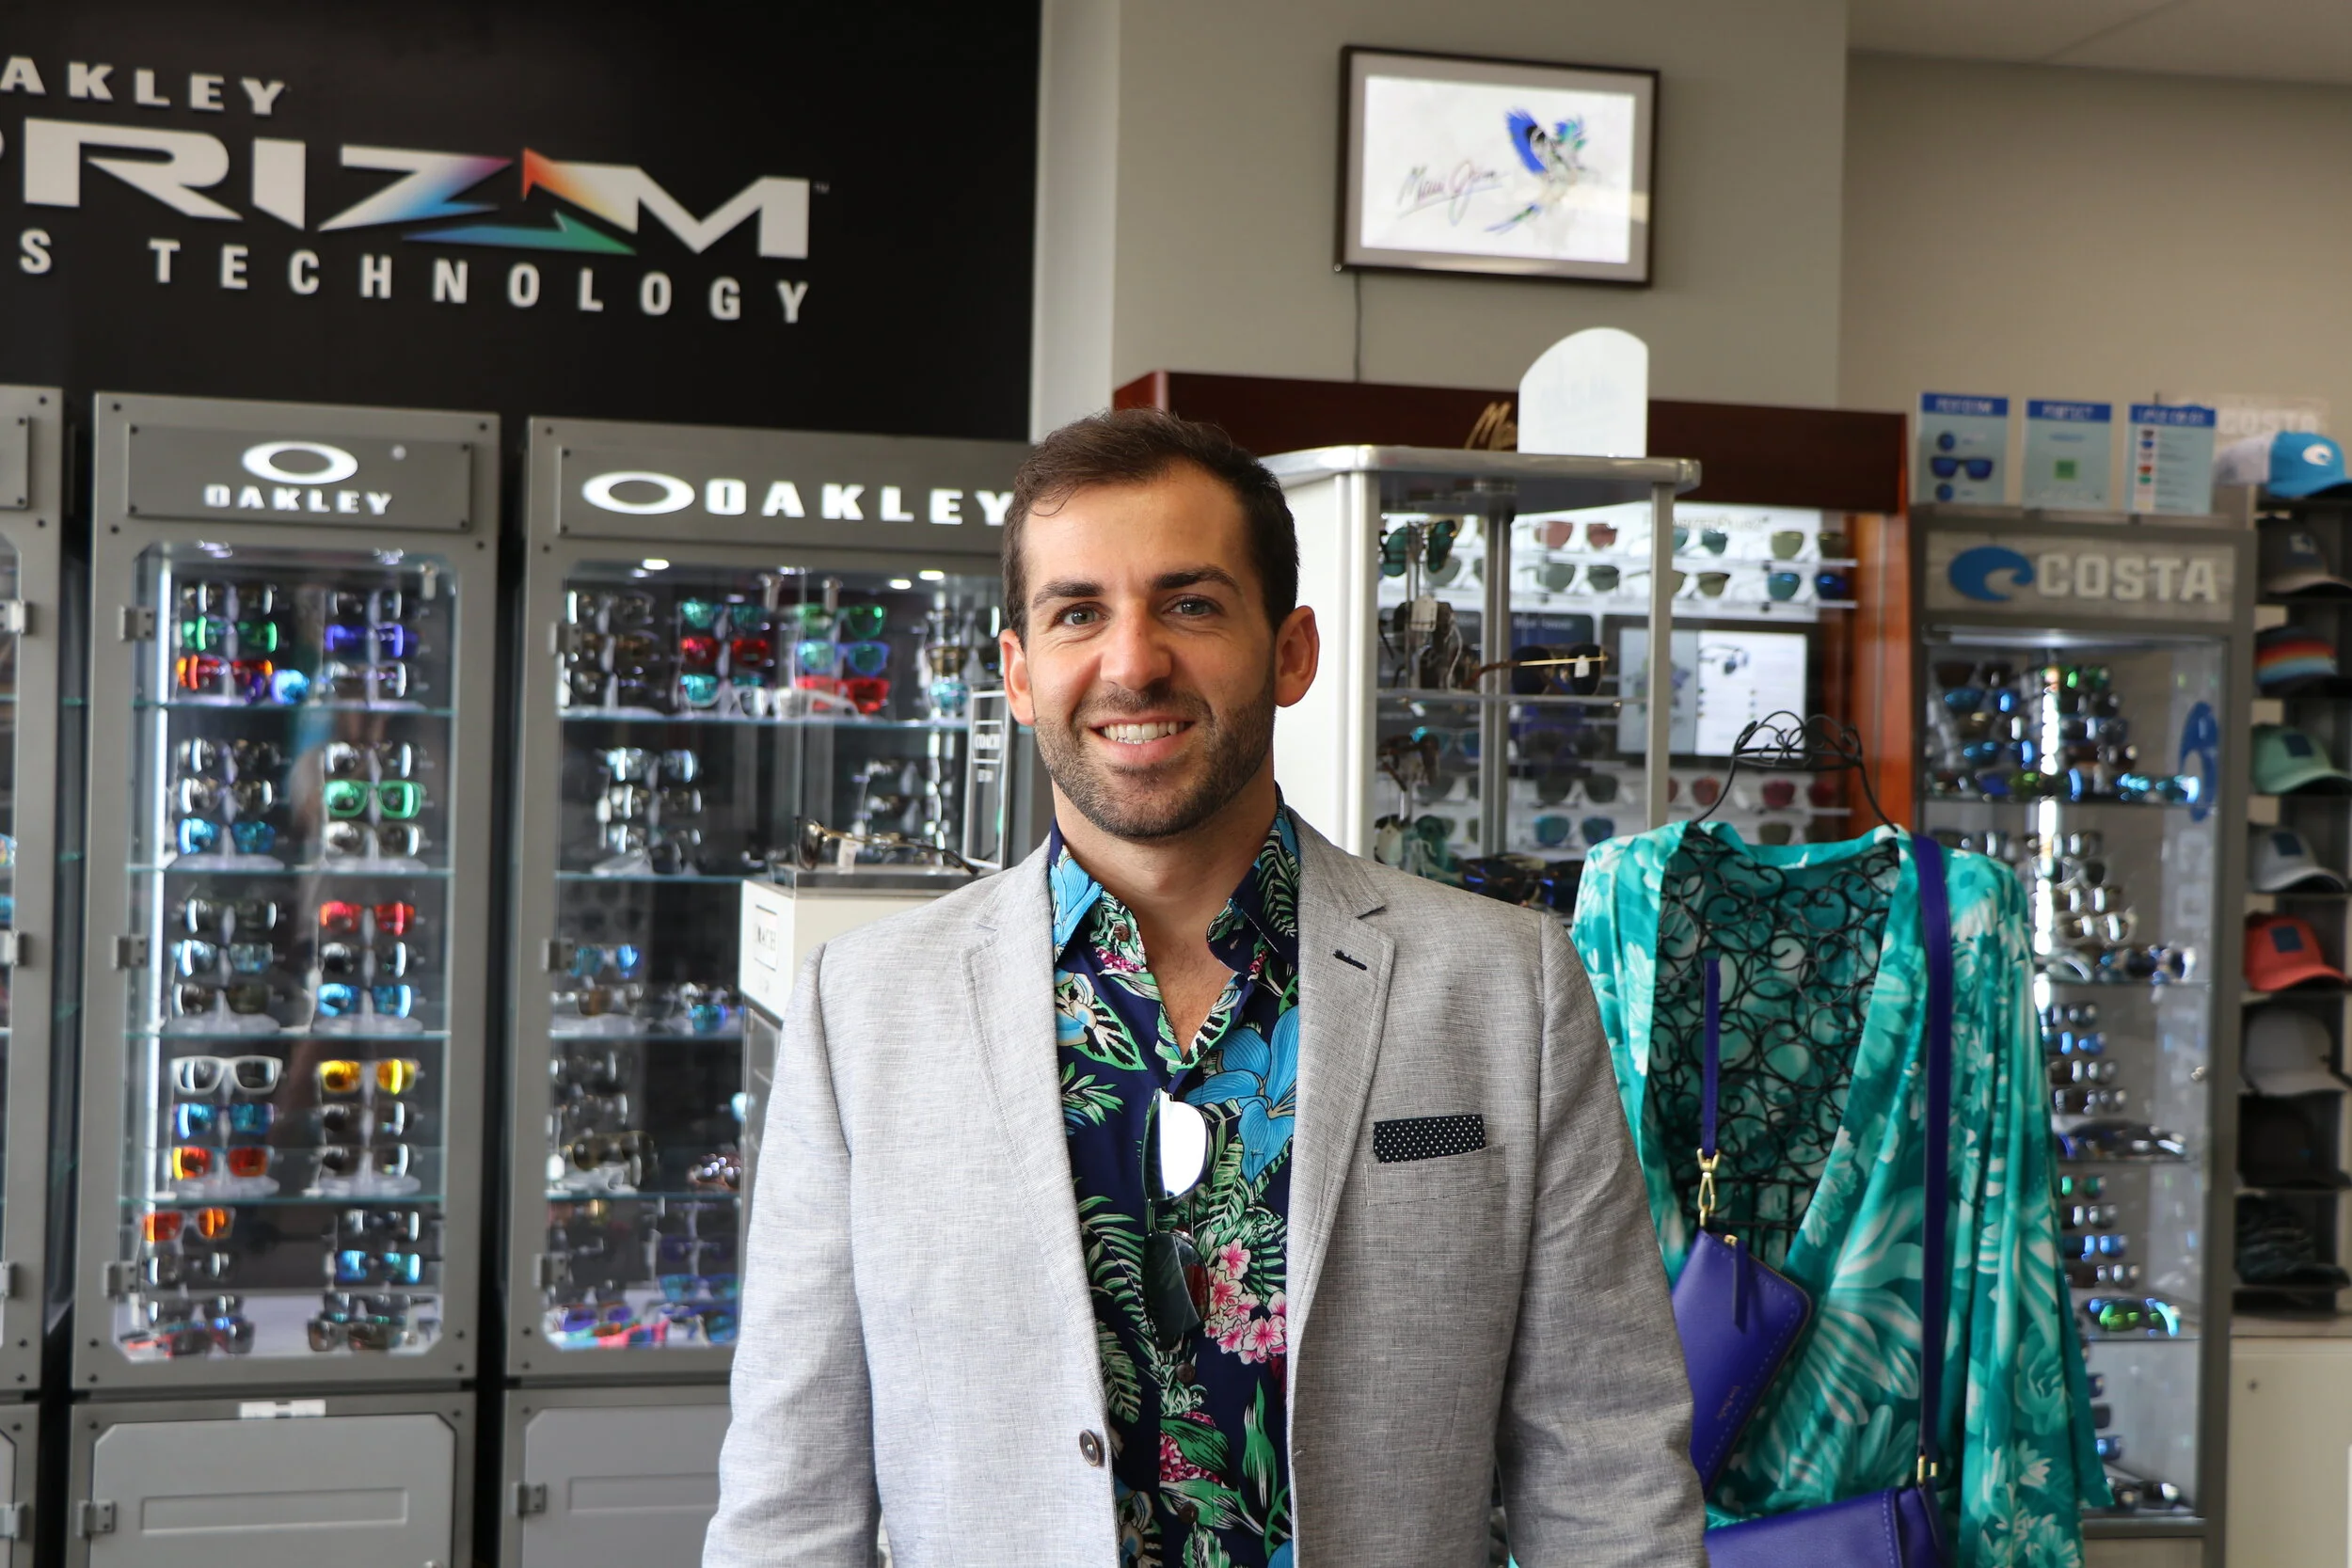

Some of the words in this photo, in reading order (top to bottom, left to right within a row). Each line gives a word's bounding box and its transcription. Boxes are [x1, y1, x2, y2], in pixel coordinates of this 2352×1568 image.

[0, 117, 810, 259] RIZM
[148, 237, 809, 324] TECHNOLOGY
[203, 483, 393, 516] OAKLEY
[705, 478, 1014, 527] OAKLEY
[2036, 552, 2217, 604] COSTA
